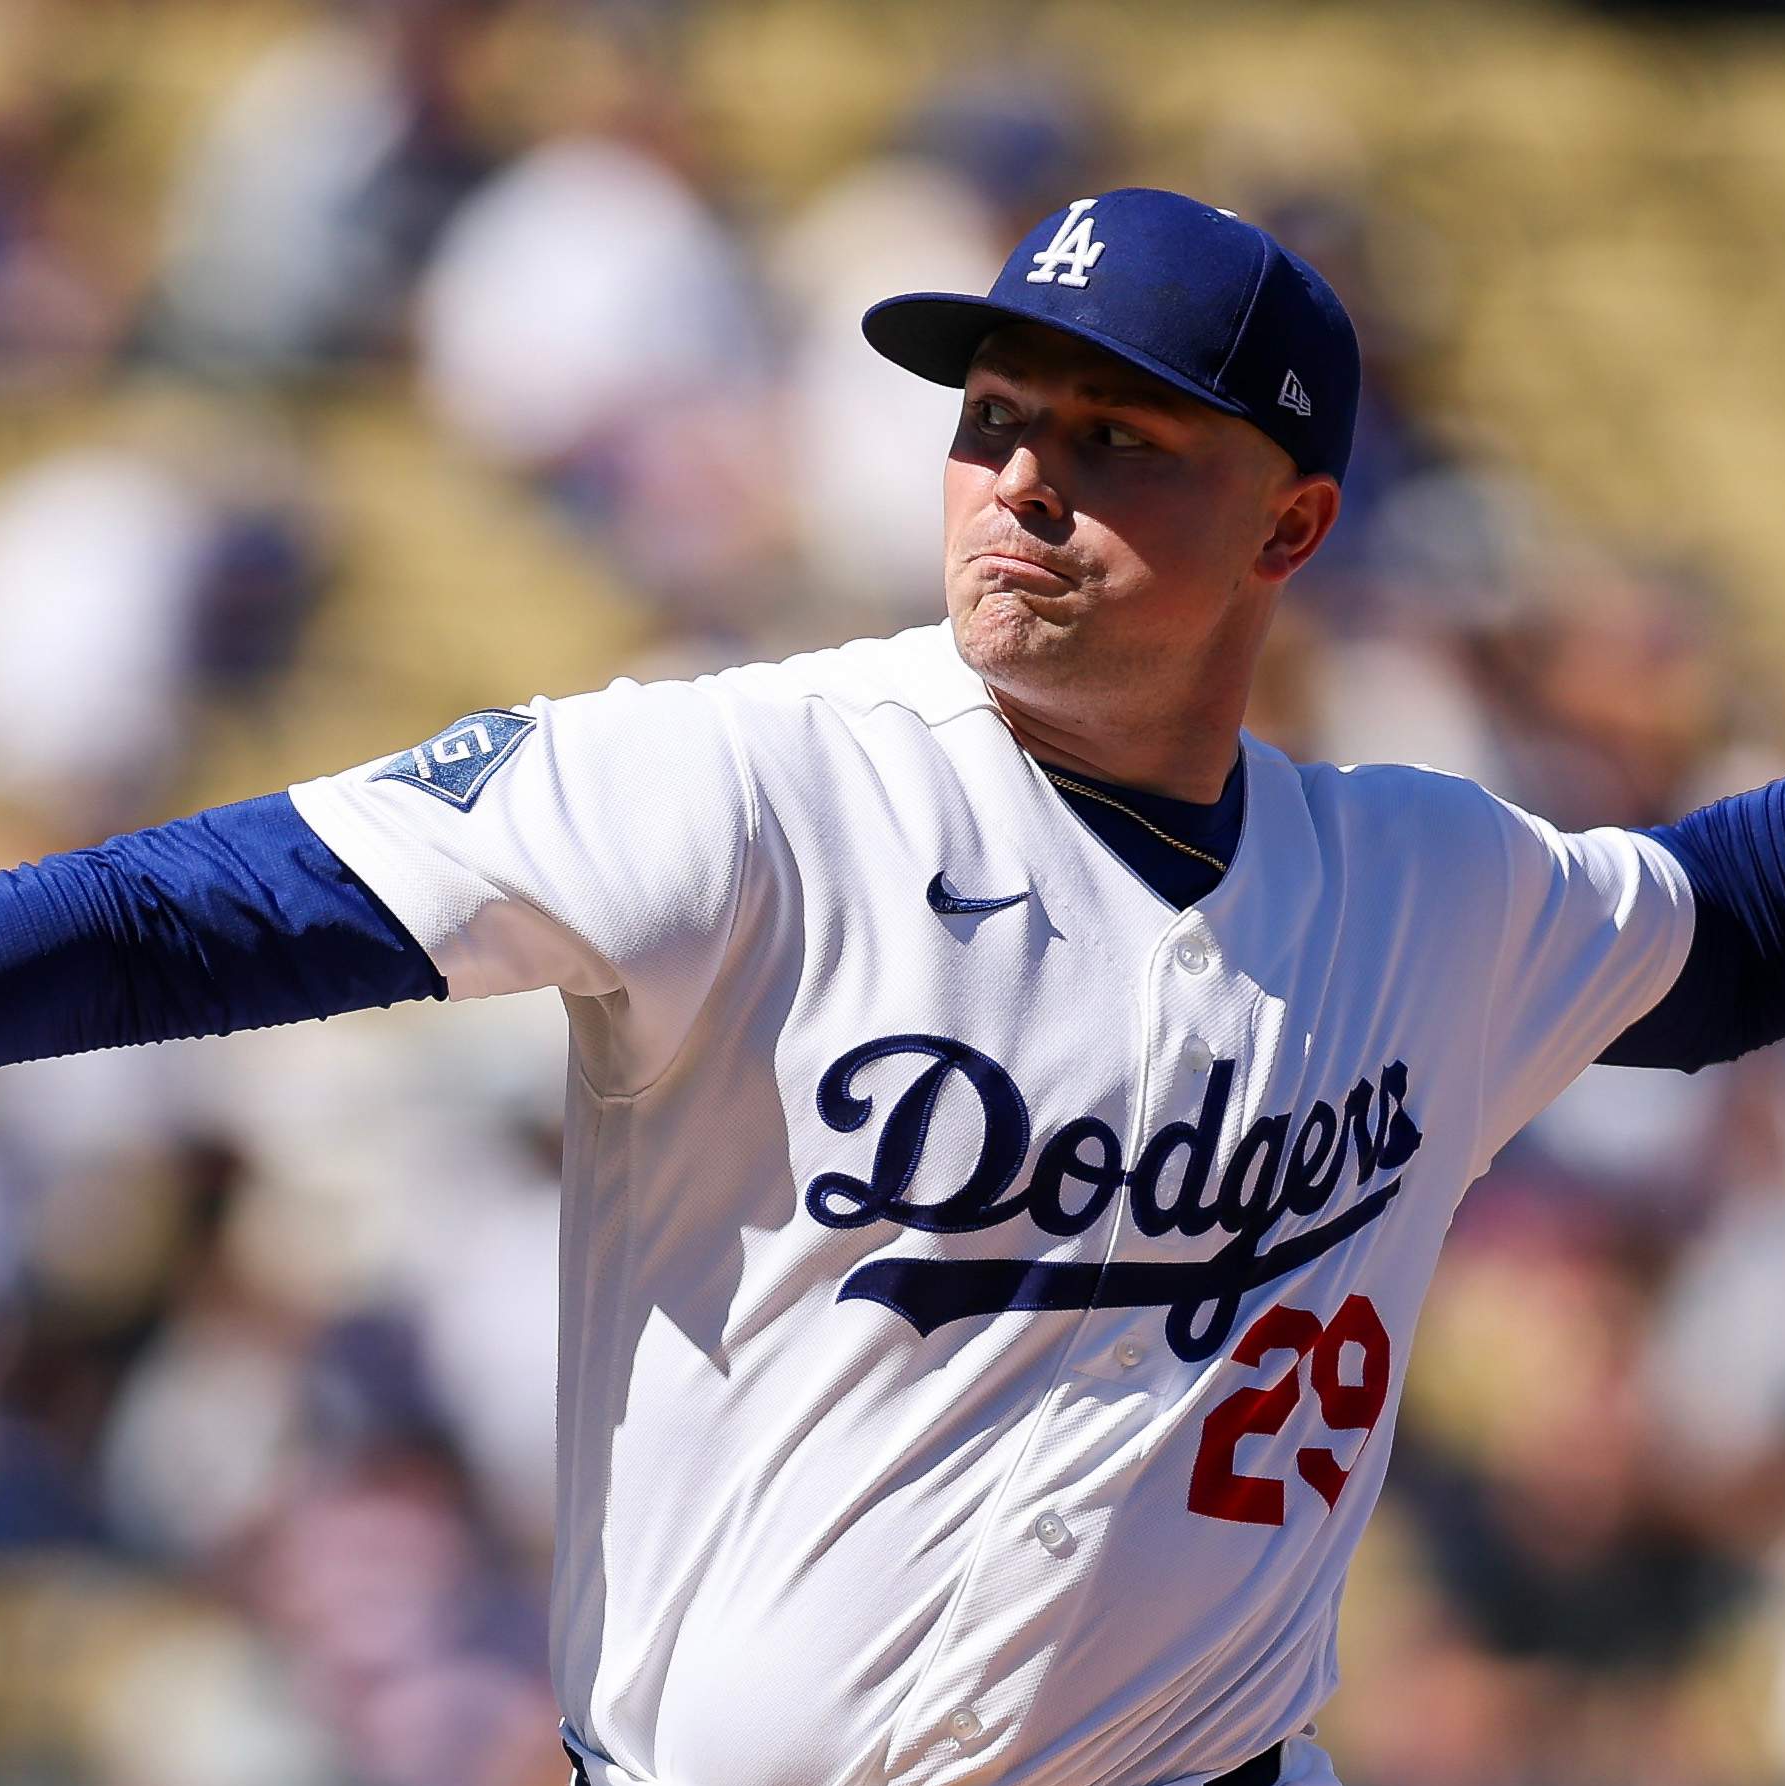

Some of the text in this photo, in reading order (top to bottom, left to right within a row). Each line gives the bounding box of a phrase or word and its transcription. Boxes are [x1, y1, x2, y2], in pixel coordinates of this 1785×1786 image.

[1025, 197, 1106, 288] LA
[805, 1033, 1423, 1364] Dodgers
[1187, 1293, 1392, 1527] 29
